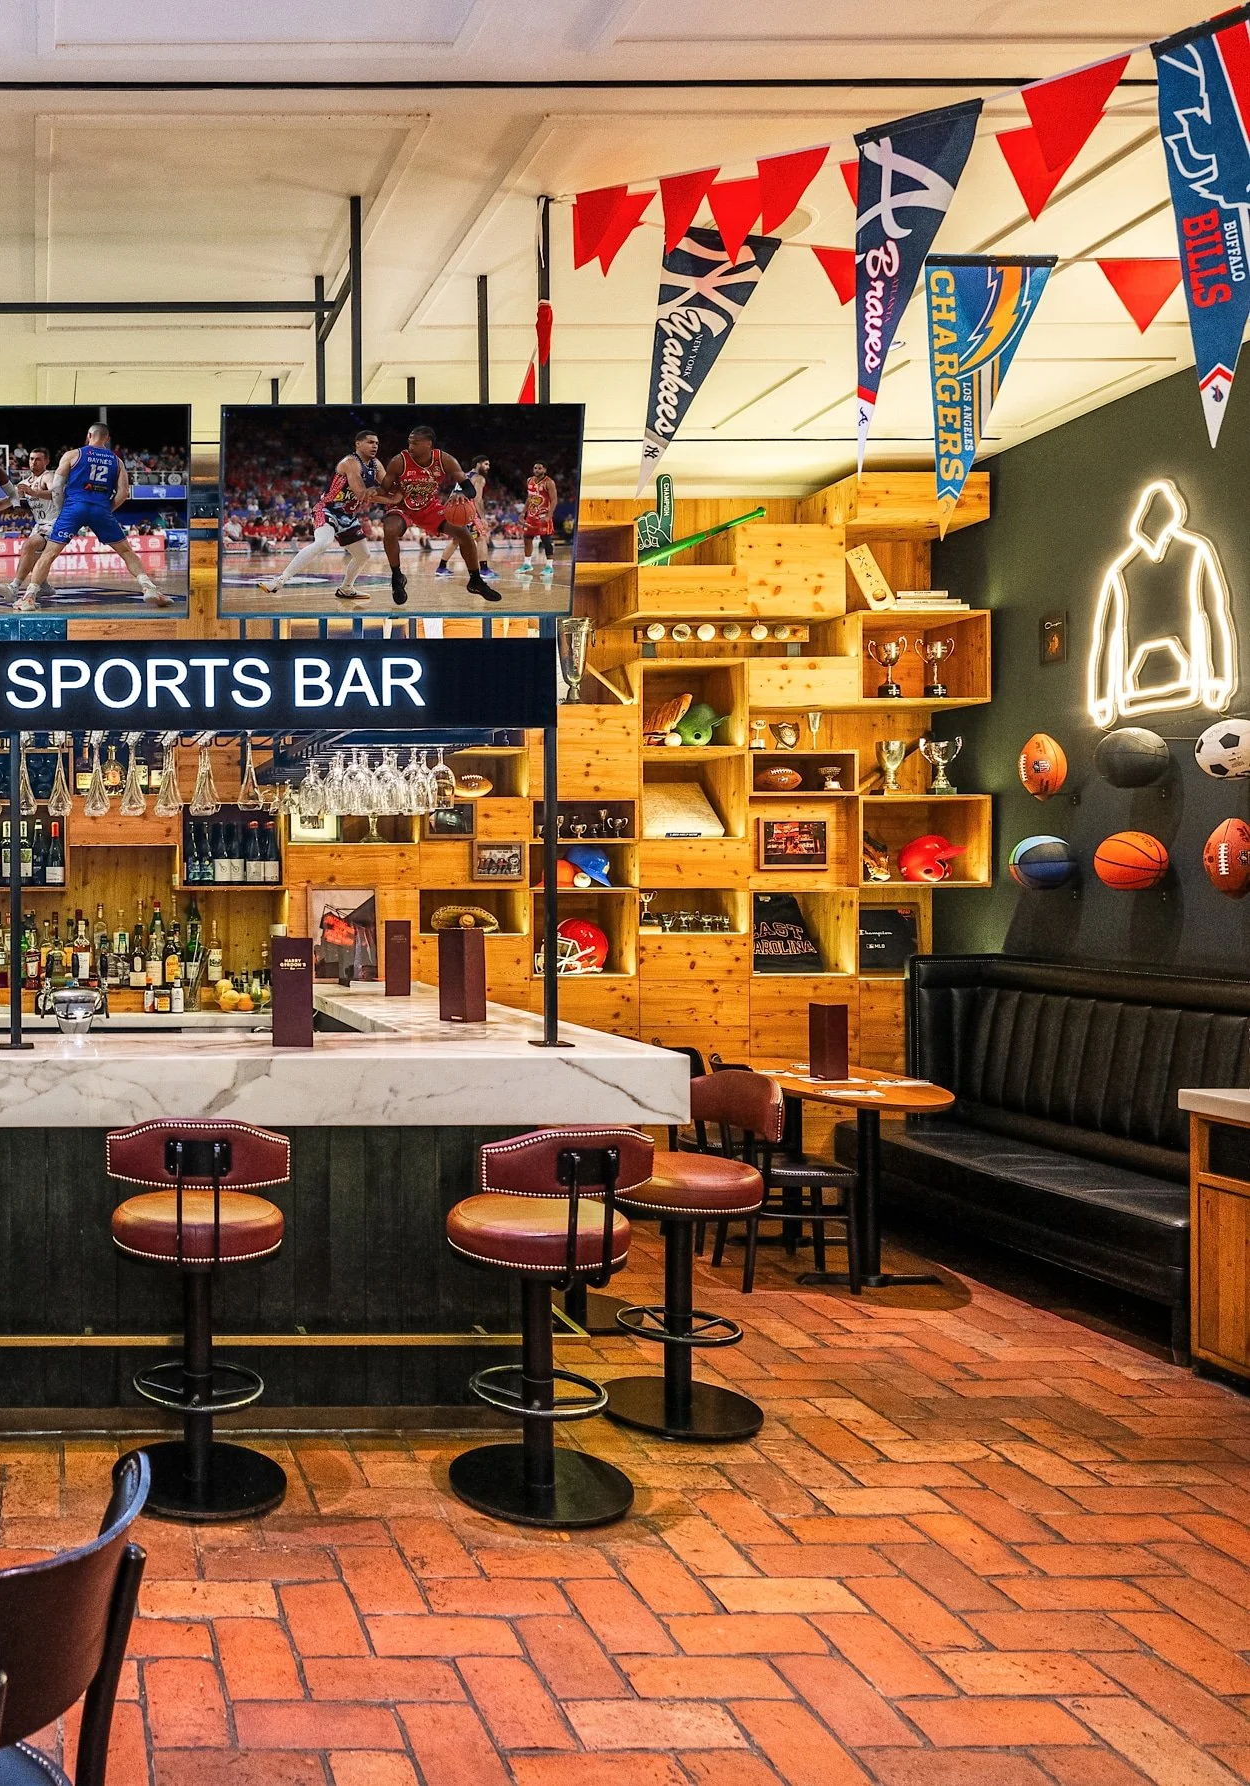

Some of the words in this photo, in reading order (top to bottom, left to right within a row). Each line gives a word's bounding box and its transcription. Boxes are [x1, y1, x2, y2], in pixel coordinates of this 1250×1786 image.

[1182, 208, 1231, 309] BILLS
[1224, 220, 1246, 283] BUFFALO
[864, 239, 900, 375] Braves
[693, 333, 704, 356] NEW
[654, 308, 702, 436] Yankees
[683, 354, 698, 377] YORK
[930, 270, 964, 482] CHARGERS
[963, 381, 972, 402] LOS
[963, 404, 974, 451] ANGELES
[87, 456, 113, 466] BAYNES
[89, 464, 110, 483] 12
[663, 482, 671, 517] CHAMPION
[5, 657, 273, 710] SPORTS
[293, 656, 427, 709] BAR
[753, 921, 804, 940] AST
[753, 939, 818, 956] AROLINA
